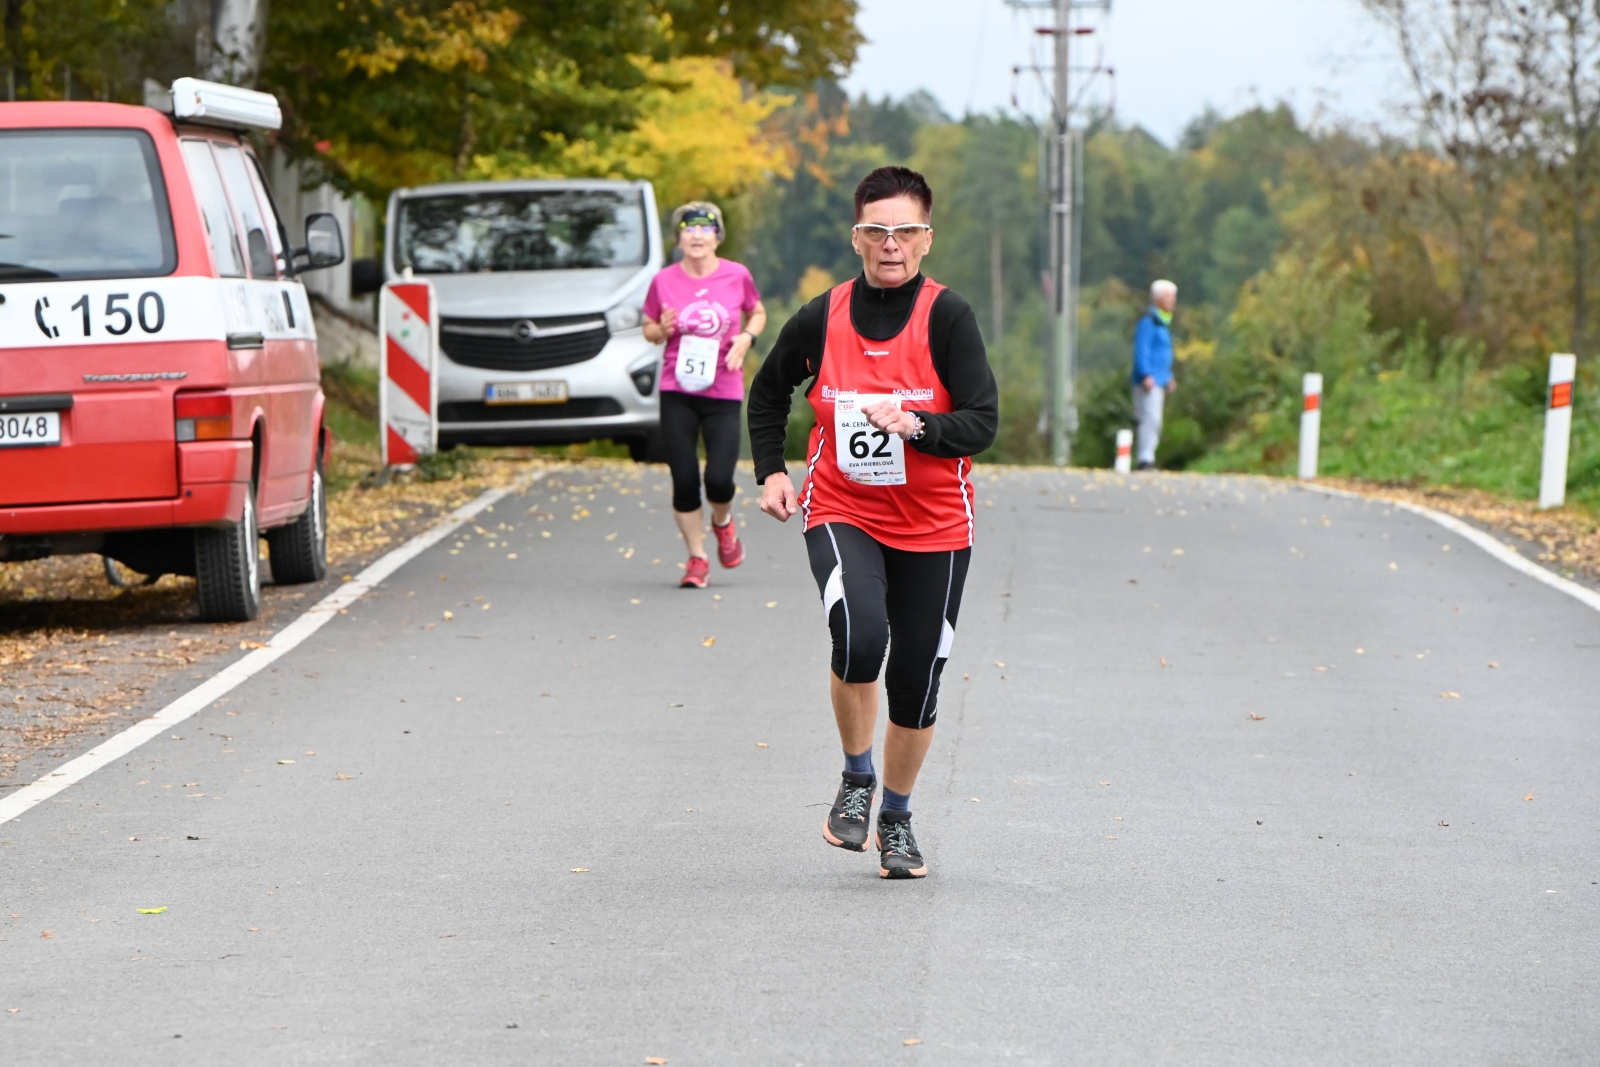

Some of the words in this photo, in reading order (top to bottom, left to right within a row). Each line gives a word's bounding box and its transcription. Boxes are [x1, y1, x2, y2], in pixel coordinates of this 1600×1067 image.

[71, 291, 165, 337] 150
[684, 358, 705, 376] 51
[83, 371, 188, 383] Transporter
[893, 388, 933, 397] MARATON
[837, 403, 855, 411] CUP
[849, 430, 892, 459] 62
